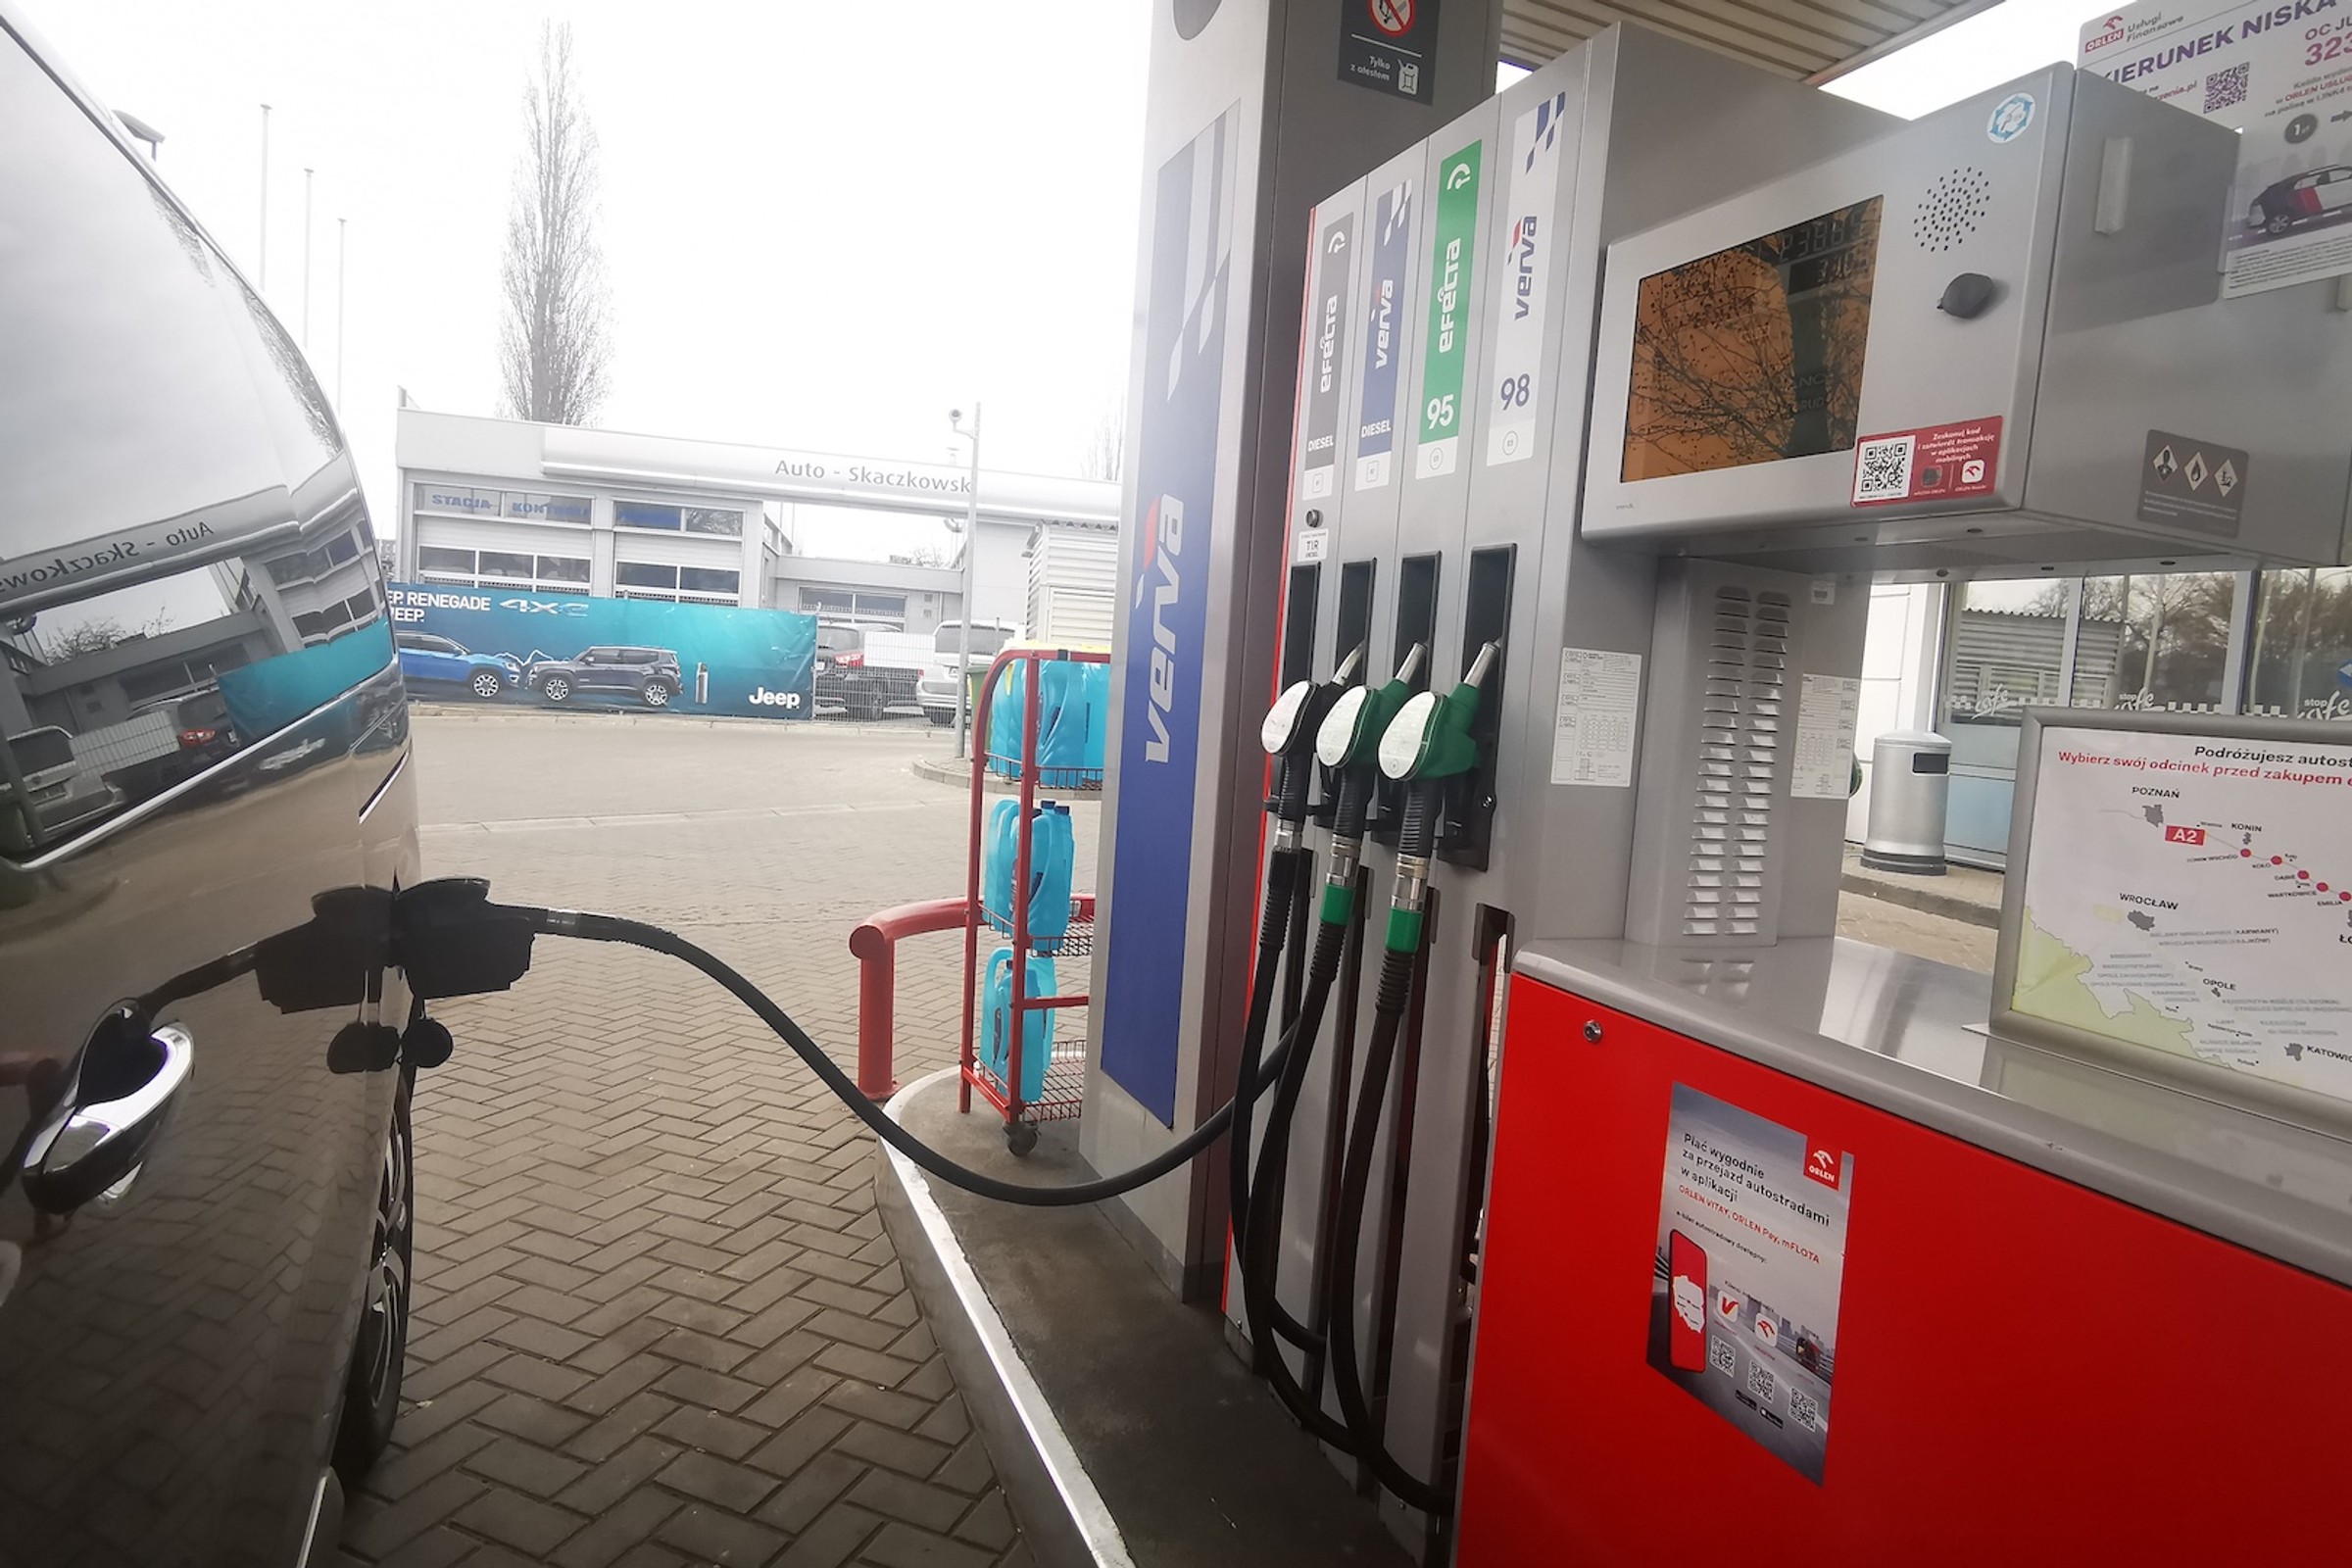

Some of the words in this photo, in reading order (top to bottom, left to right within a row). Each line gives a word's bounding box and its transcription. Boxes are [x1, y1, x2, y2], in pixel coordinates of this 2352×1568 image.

[2127, 15, 2184, 42] Finansowe
[2305, 23, 2331, 40] OC
[2085, 29, 2124, 52] ORLEN
[1369, 55, 1391, 70] Tylko
[2104, 24, 2234, 83] IERUNEK
[1357, 66, 1391, 81] atestem
[2284, 84, 2319, 102] ORLEN
[1514, 216, 1538, 321] verva
[1375, 278, 1394, 370] verva
[1499, 372, 1531, 411] 98
[1426, 393, 1455, 430] 95
[1360, 417, 1392, 439] DIESEL
[1307, 433, 1334, 453] DIESEL
[774, 460, 825, 479] Auto
[431, 494, 491, 510] STACJA
[407, 592, 491, 612] RENEGADE
[1145, 493, 1185, 763] verva
[748, 686, 801, 710] Jeep
[2303, 699, 2328, 708] stop
[2194, 745, 2294, 764] Podróżujesz
[2058, 751, 2111, 765] Wybierz
[2113, 757, 2147, 771] swój
[2149, 759, 2210, 774] odcinek
[2213, 764, 2261, 778] przed
[2263, 768, 2342, 785] zakupem
[2132, 786, 2180, 799] POZNAŃ
[2173, 828, 2198, 844] A2
[2230, 822, 2262, 832] KONIN
[2119, 892, 2180, 910] WROCŁAW
[2202, 978, 2236, 991] OPOLE
[1709, 1149, 1765, 1180] wygodnie
[1808, 1164, 1836, 1183] ORLEN
[1680, 1166, 1690, 1177] w
[1691, 1172, 1739, 1202] aplikacji
[1682, 1149, 1695, 1161] za
[1695, 1154, 1743, 1186] przejazd
[1745, 1179, 1831, 1228] autostradami
[1678, 1184, 1705, 1205] ORLEN
[1732, 1211, 1762, 1236] ORLEN
[1781, 1239, 1821, 1265] mFLOTA
